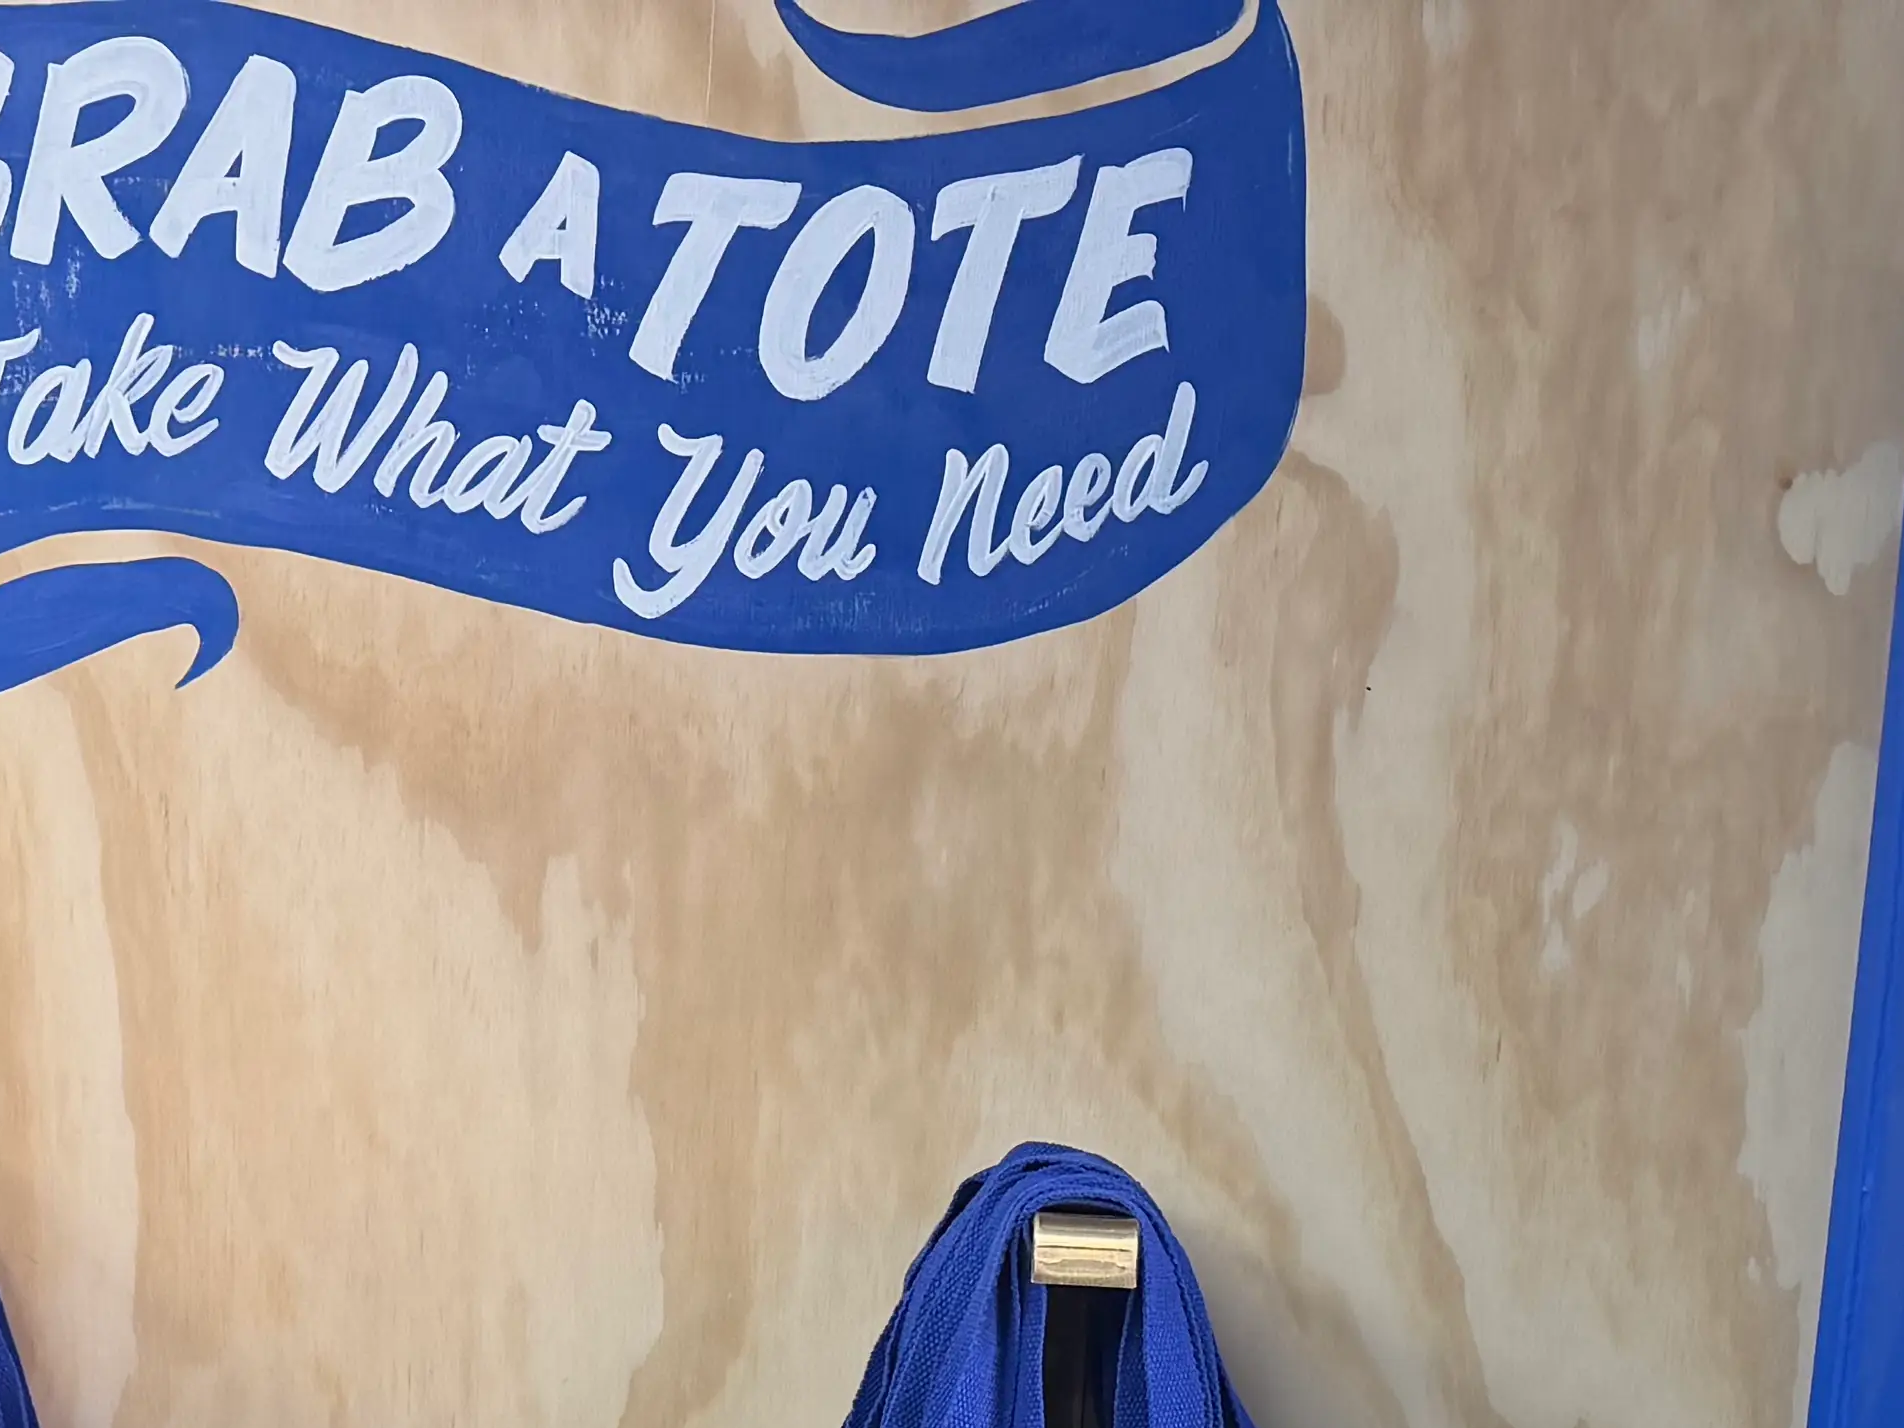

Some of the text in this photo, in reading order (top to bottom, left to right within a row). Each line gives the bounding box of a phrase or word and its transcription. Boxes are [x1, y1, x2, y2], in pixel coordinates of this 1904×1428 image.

[498, 150, 600, 300] A
[628, 147, 1193, 402] TOTE
[264, 340, 614, 534] What
[612, 423, 877, 620] You
[917, 381, 1209, 585] Need
